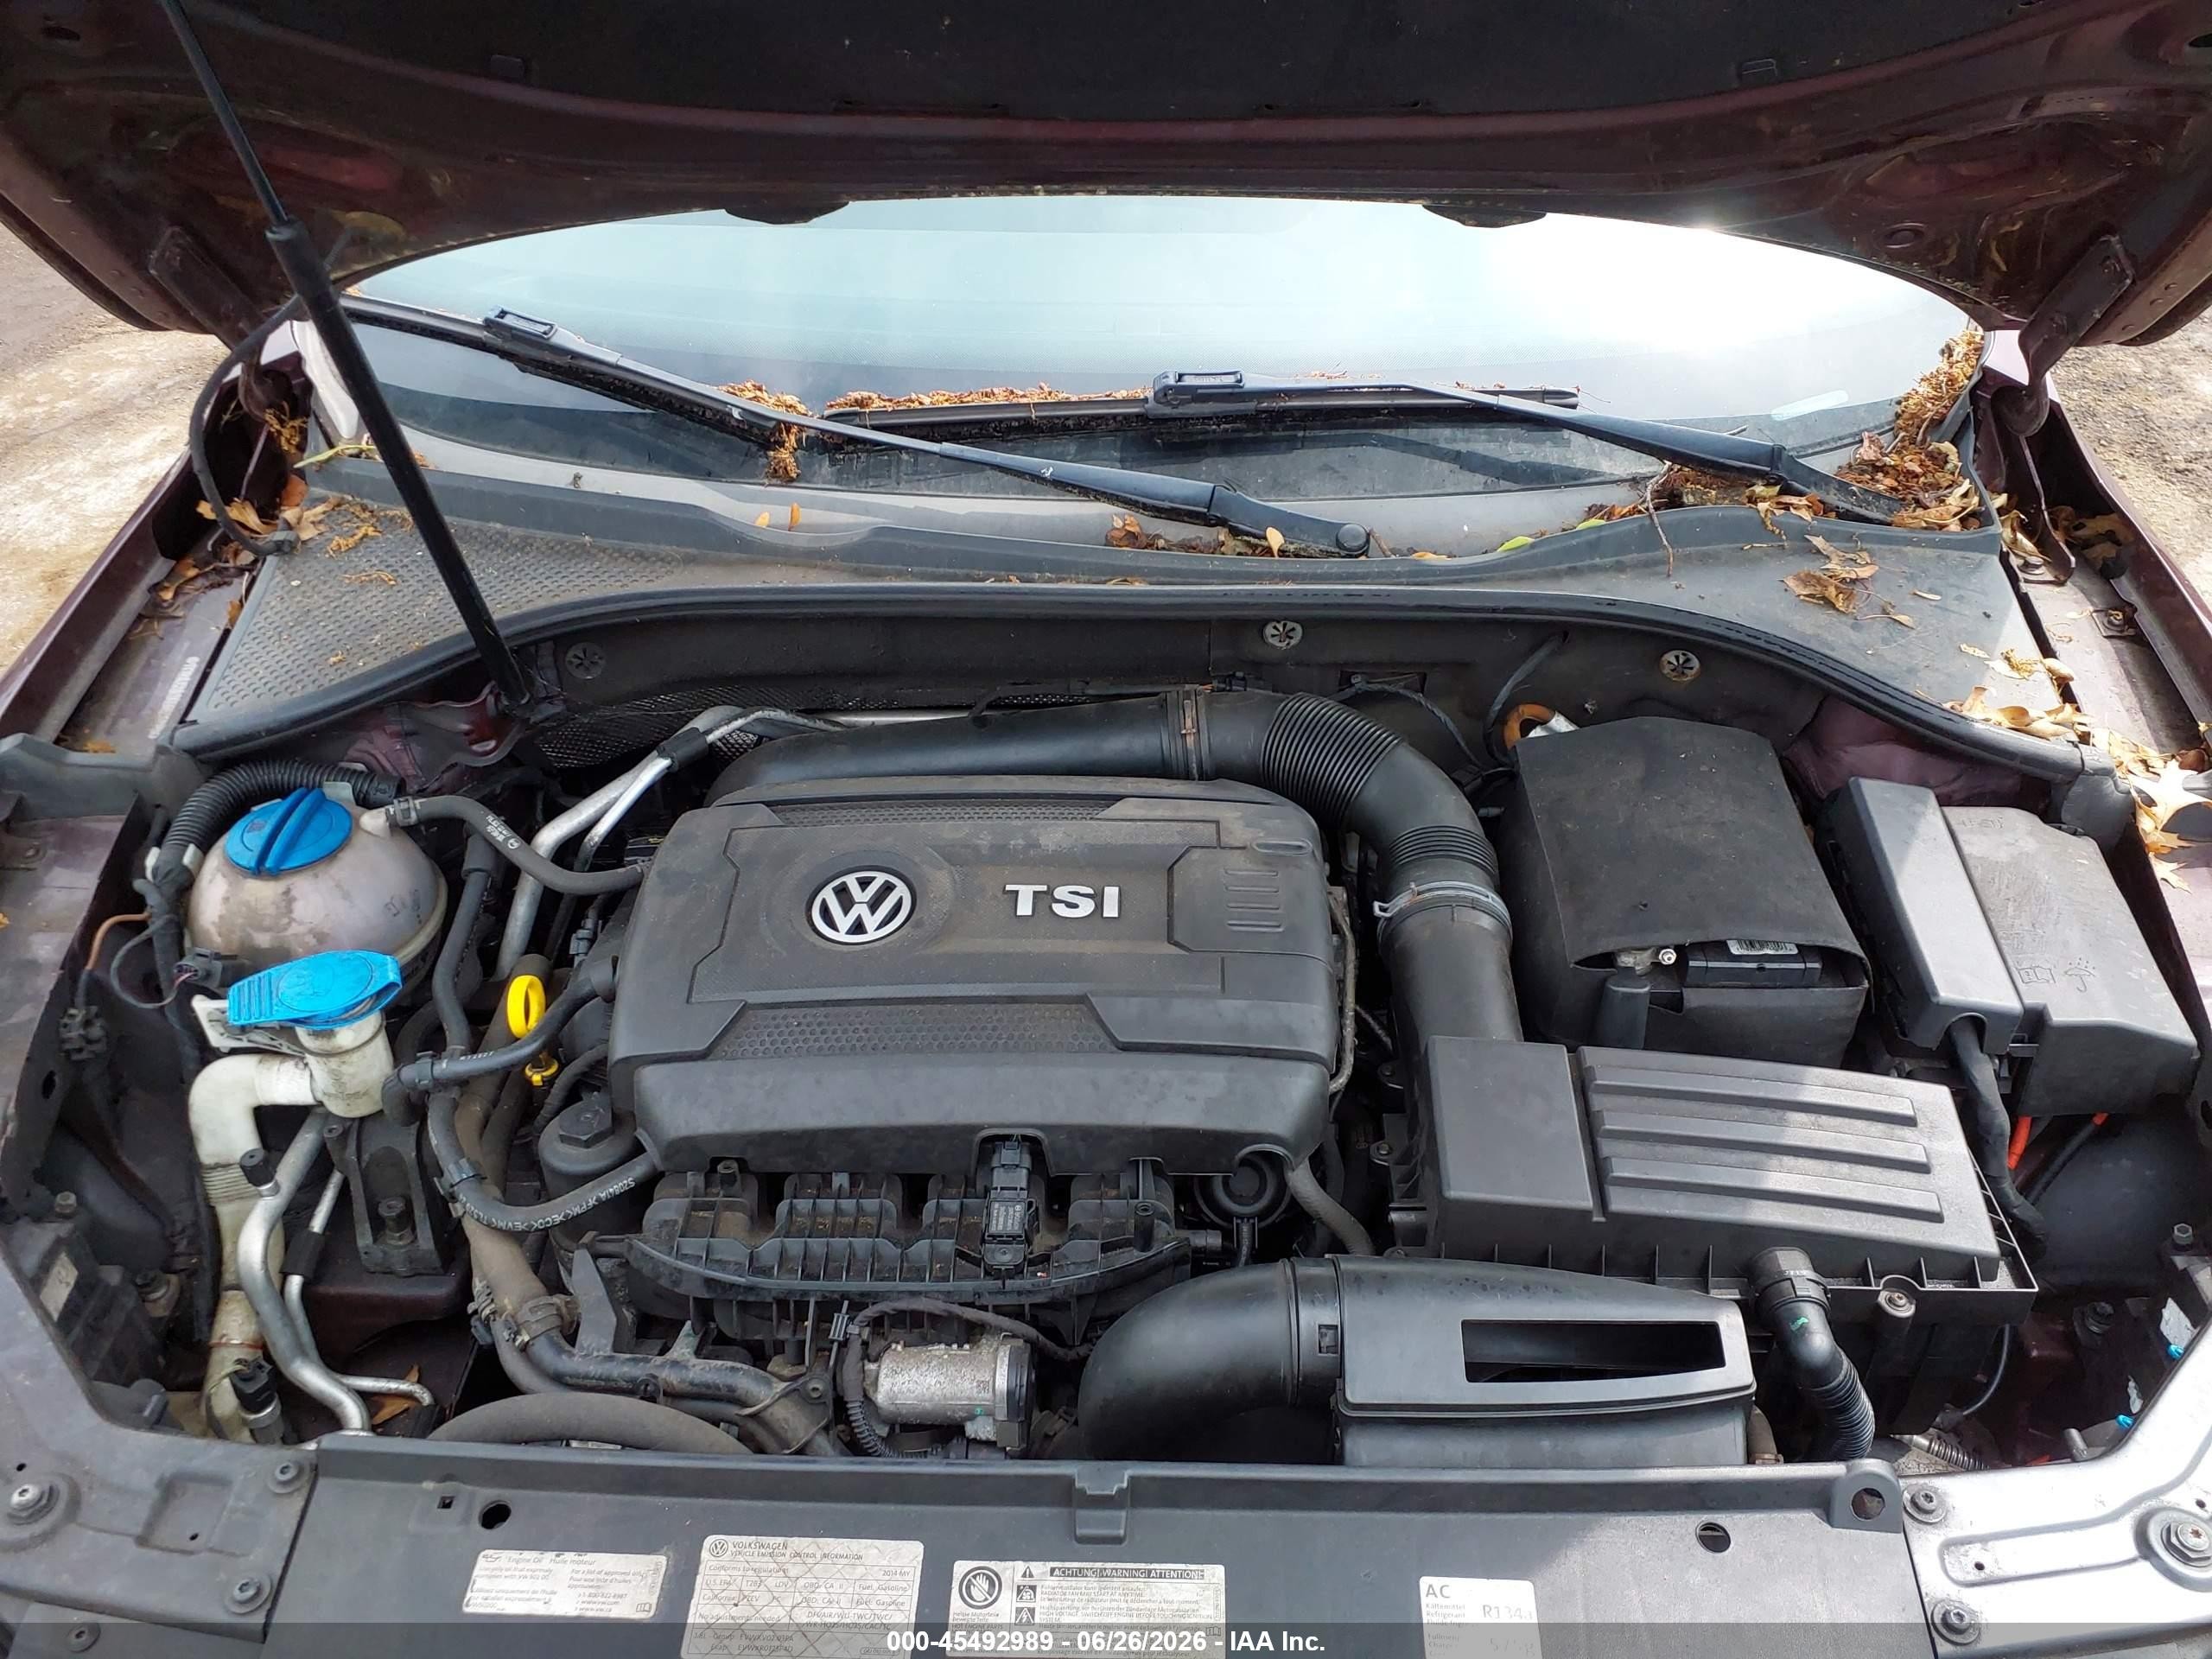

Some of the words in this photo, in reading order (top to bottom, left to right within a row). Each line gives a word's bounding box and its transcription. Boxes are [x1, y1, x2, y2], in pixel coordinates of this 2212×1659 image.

[1004, 884, 1121, 920] TSI
[732, 1541, 788, 1551] VOLKSWAGEN
[507, 1556, 531, 1565] Engine
[820, 1552, 863, 1560] INFORMATION
[709, 1564, 741, 1573] Conforms
[1102, 1569, 1148, 1579] WARNING!
[877, 1584, 908, 1592] Gasoline
[1426, 1584, 1452, 1599] AC
